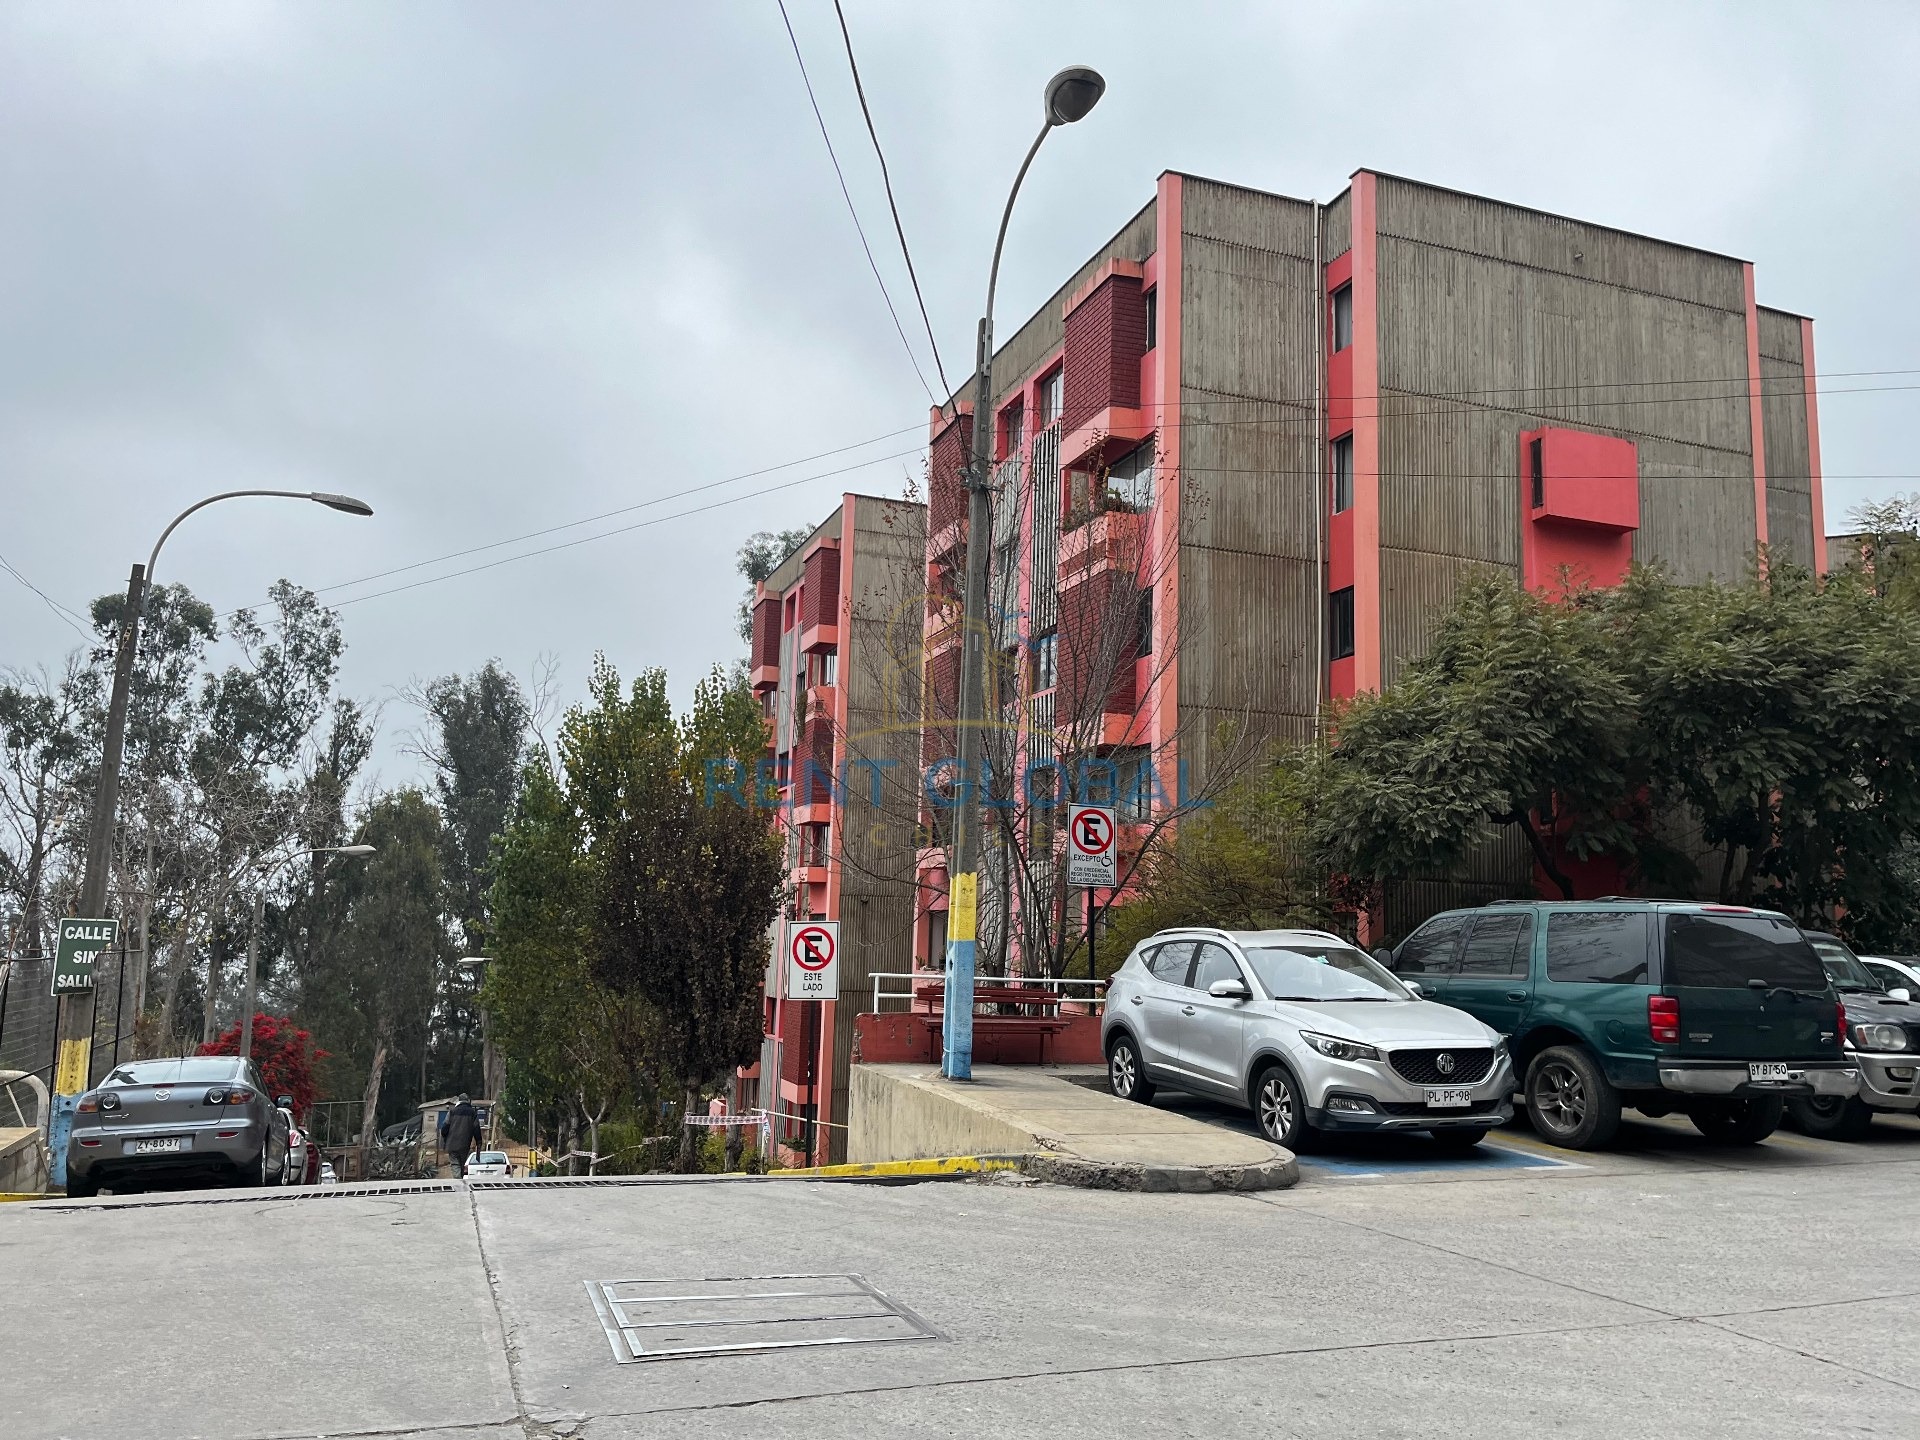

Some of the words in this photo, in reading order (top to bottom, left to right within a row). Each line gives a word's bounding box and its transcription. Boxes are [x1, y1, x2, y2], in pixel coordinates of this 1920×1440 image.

[1073, 854, 1101, 862] EXCEPTO
[64, 926, 112, 941] CALLE
[803, 973, 823, 981] ESTE
[802, 983, 823, 991] LADO
